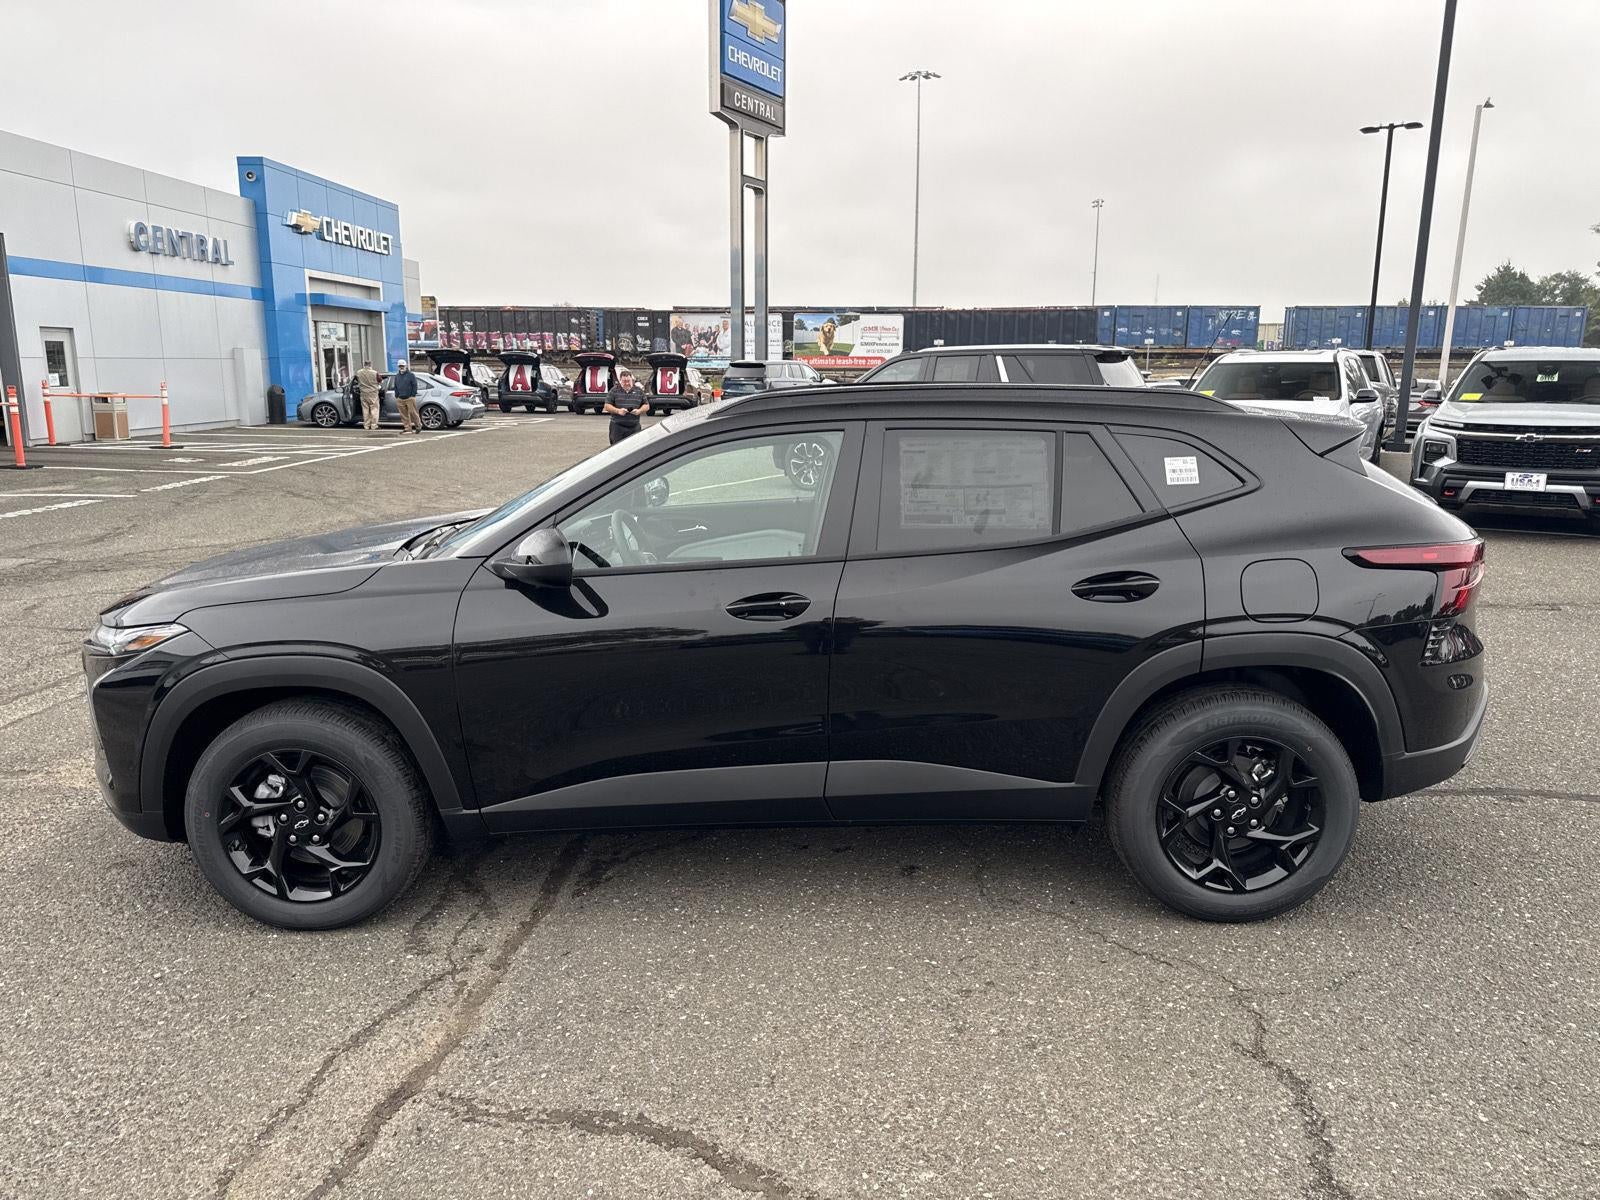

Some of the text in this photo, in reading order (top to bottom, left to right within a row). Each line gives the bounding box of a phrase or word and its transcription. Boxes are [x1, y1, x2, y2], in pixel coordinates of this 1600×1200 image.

[728, 45, 782, 82] CHEVROLET
[734, 91, 776, 121] CENTRAL
[129, 221, 235, 266] CENTRAL
[321, 215, 393, 256] CHEVROLET
[809, 357, 835, 365] ultimate
[836, 357, 866, 365] leash-free
